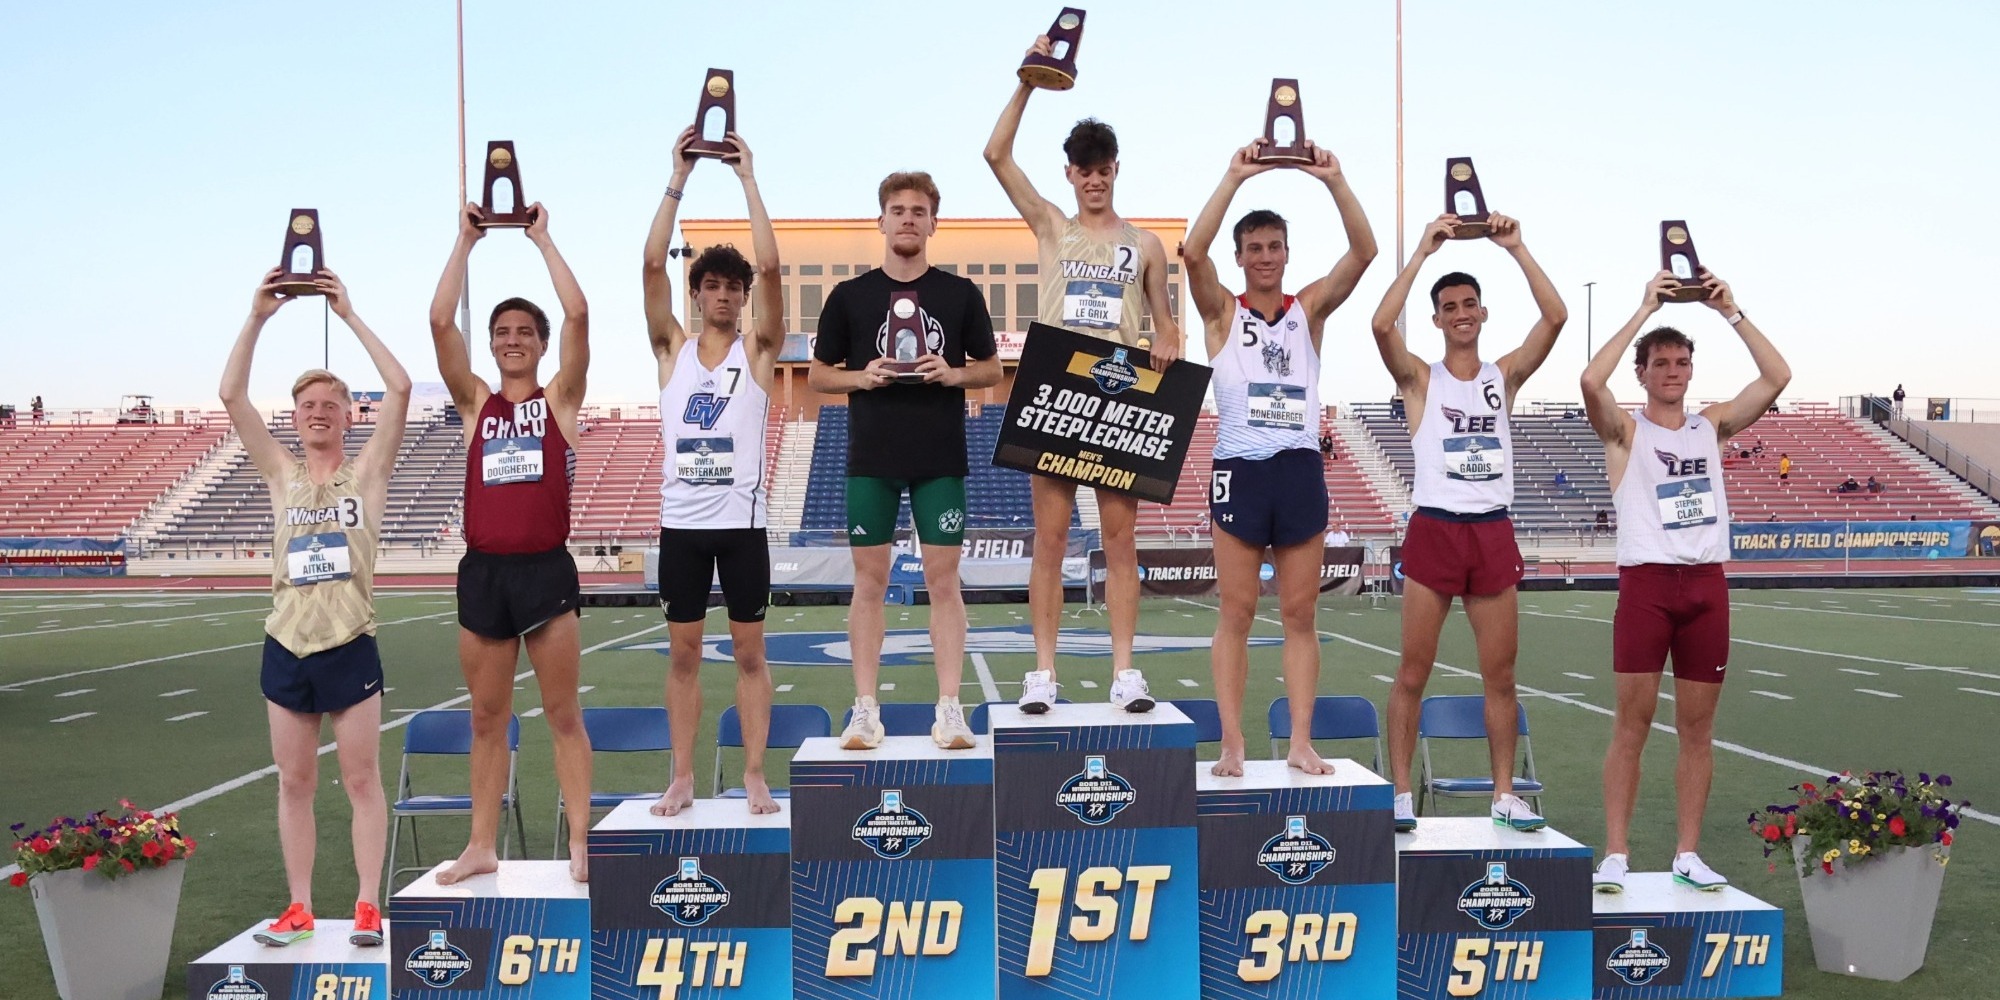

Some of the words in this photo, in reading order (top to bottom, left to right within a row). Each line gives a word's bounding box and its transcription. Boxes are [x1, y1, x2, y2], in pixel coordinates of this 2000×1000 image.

[1119, 247, 1133, 273] 2
[1060, 260, 1138, 284] WINGATE
[1079, 299, 1106, 308] TITOUAN
[1076, 308, 1086, 317] LE
[1088, 309, 1108, 320] GRIX
[1243, 322, 1258, 347] 5
[727, 368, 741, 394] 7
[1270, 402, 1286, 410] MAX
[1484, 385, 1502, 411] 6
[520, 401, 541, 420] 10
[683, 393, 731, 430] GV
[1033, 384, 1102, 418] 3,000
[1101, 401, 1175, 436] METER
[1250, 409, 1304, 422] BONENBERGER
[1453, 416, 1497, 434] LEE
[1016, 406, 1173, 461] STEEPLECHASE
[498, 456, 524, 464] HUNTER
[694, 458, 714, 466] OWEN
[1078, 450, 1103, 462] MEN'S
[1468, 454, 1484, 462] LUKE
[488, 464, 538, 478] DOUGHERTY
[678, 466, 732, 476] WESTERKAMP
[1036, 452, 1136, 490] CHAMPION
[1460, 463, 1492, 472] GADDIS
[1667, 457, 1707, 476] LEE
[1216, 473, 1228, 500] 5
[1675, 498, 1702, 508] STEPHEN
[286, 507, 340, 526] WINGA
[344, 498, 358, 527] 3
[1678, 508, 1704, 520] CLARK
[974, 540, 1024, 558] FIELD
[1732, 534, 1778, 550] TRACK
[1780, 534, 1790, 548] &
[1794, 533, 1830, 548] FIELD
[1835, 532, 1950, 548] CHAMPIONSHIPS
[309, 554, 326, 562] WILL
[774, 562, 798, 570] GILL
[303, 562, 335, 575] AITKEN
[1148, 567, 1183, 580] TRACK
[1184, 566, 1192, 580] &
[1326, 564, 1360, 578] FIELD
[1058, 792, 1134, 802] CHAMPIONSHIPS
[855, 826, 930, 836] CHAMPIONSHIPS
[1260, 851, 1333, 862] CHAMPIONSHIPS
[653, 894, 727, 904] CHAMPIONSHIPS
[1460, 898, 1532, 908] CHAMPIONSHIPS
[1026, 865, 1171, 976] 1ST
[825, 897, 964, 976] 2ND
[1237, 910, 1357, 982] 3RD
[498, 935, 581, 984] 6TH
[1609, 958, 1668, 966] CHAMPIONSHIPS
[1701, 933, 1770, 977] 7TH
[408, 960, 469, 968] CHAMPIONSHIPS
[636, 938, 748, 1000] 4TH
[1447, 938, 1544, 996] 5TH
[313, 974, 372, 1000] 8TH
